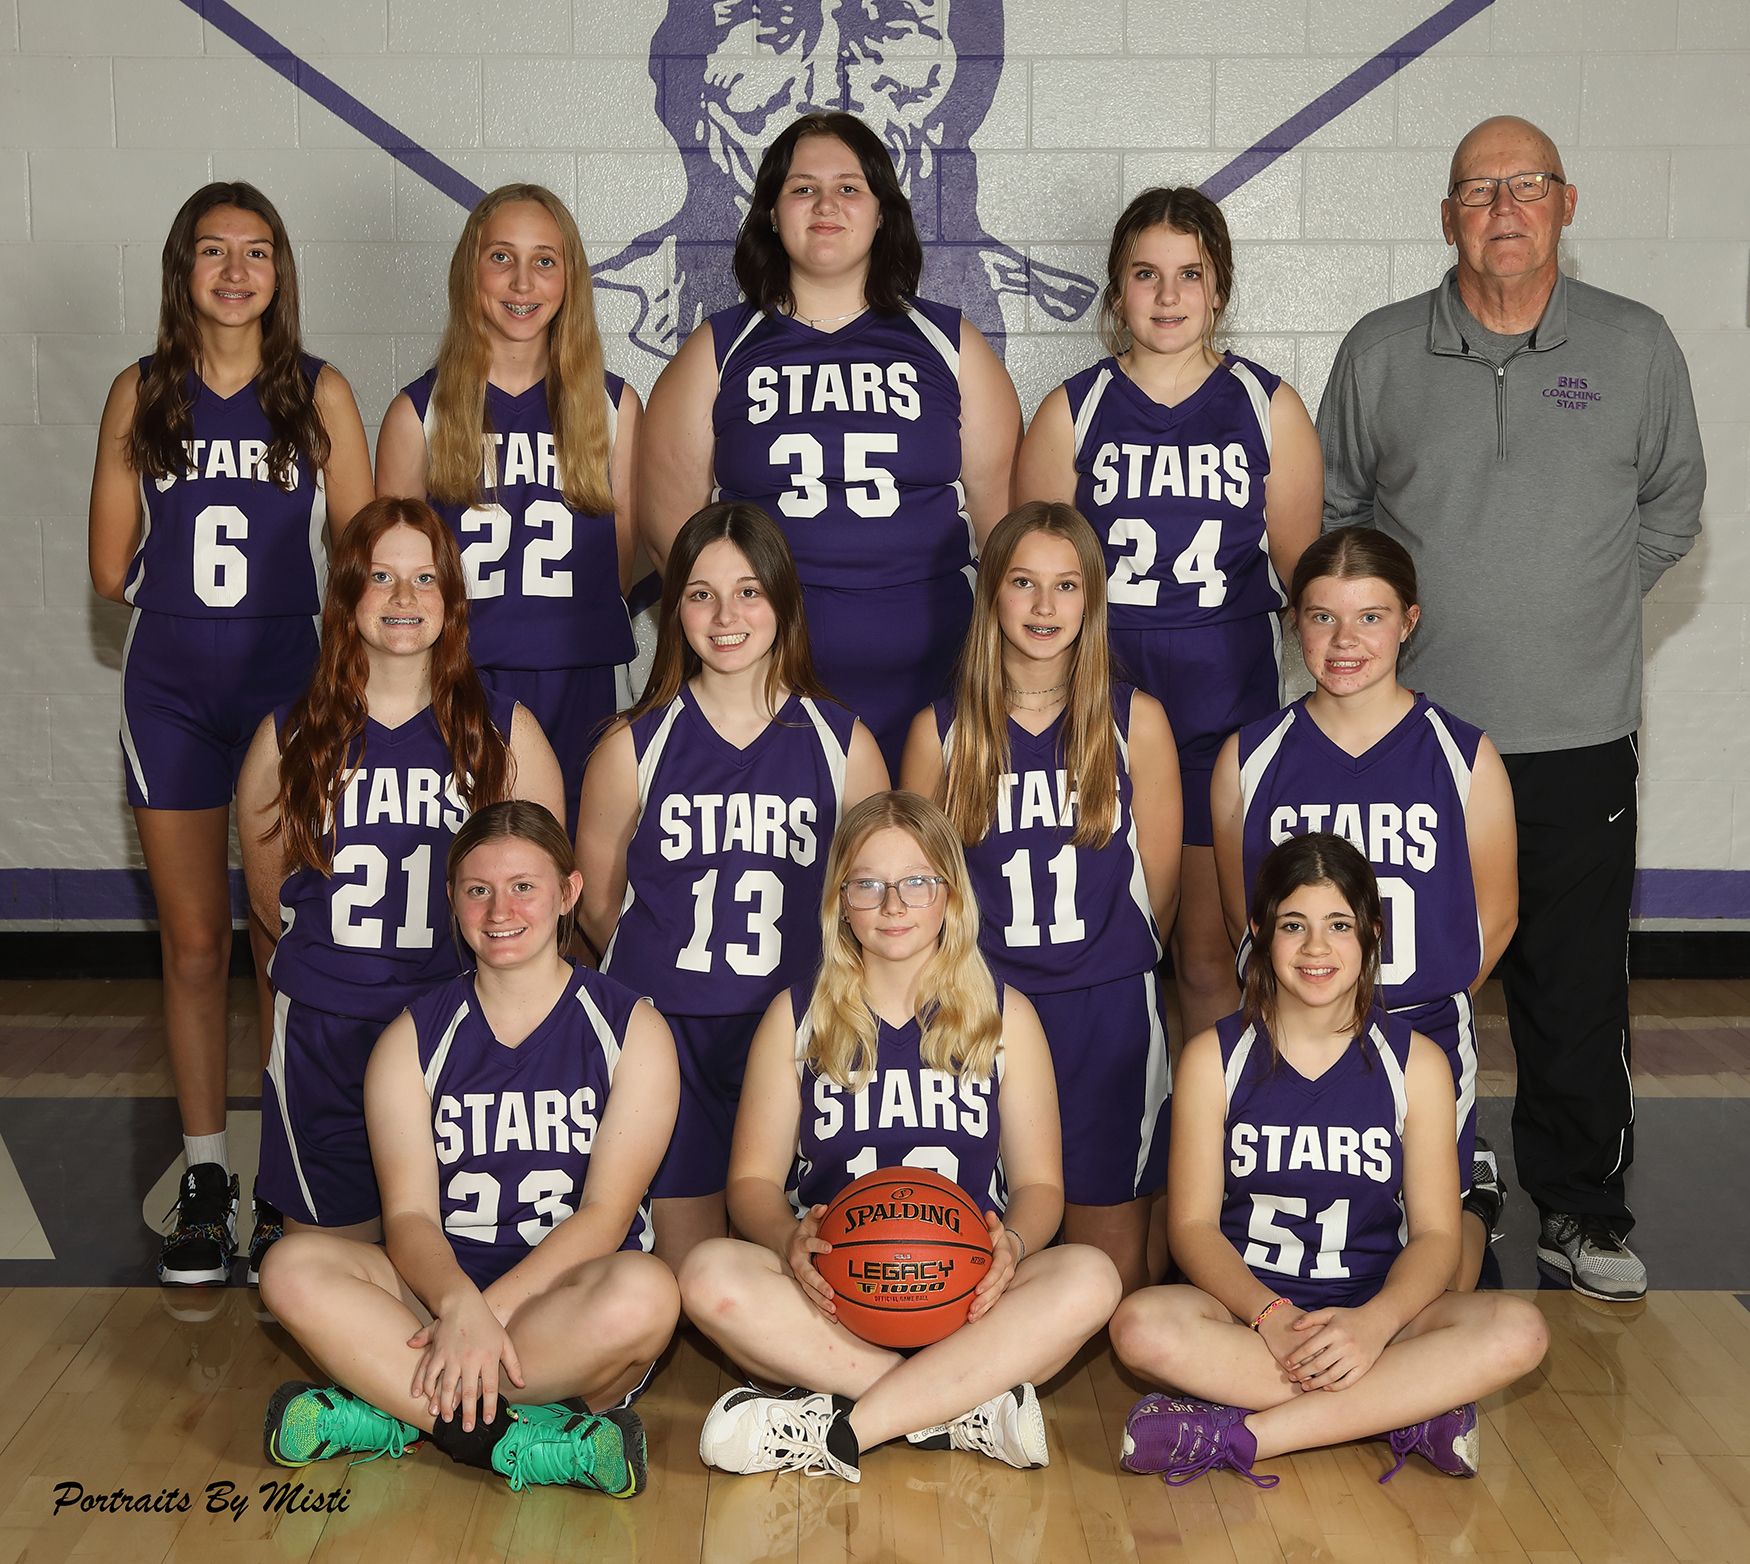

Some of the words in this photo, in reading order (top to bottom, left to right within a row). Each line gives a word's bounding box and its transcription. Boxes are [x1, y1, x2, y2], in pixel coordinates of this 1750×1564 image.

[748, 361, 922, 425] STARS
[1542, 388, 1602, 401] COACHING
[1556, 399, 1588, 410] STAFF
[1557, 376, 1588, 389] BHS
[481, 431, 565, 491] TAR
[769, 432, 901, 519] 35
[1092, 442, 1251, 508] STARS
[193, 505, 249, 608] 6
[460, 499, 574, 600] 22
[1107, 517, 1228, 608] 24
[660, 792, 818, 868] STARS
[331, 844, 434, 949] 21
[675, 868, 785, 977] 13
[1001, 844, 1086, 948] 11
[1373, 876, 1417, 986] 0
[434, 1086, 599, 1165] STARS
[813, 1068, 992, 1142] STARS
[1230, 1122, 1392, 1184] STARS
[444, 1168, 576, 1247] 23
[844, 1202, 961, 1235] SPALDING
[1243, 1192, 1350, 1279] 51
[848, 1258, 955, 1282] LEGACY
[856, 1281, 878, 1295] TF
[879, 1281, 946, 1295] 1000
[874, 1295, 899, 1303] OFFICIAL
[900, 1295, 914, 1303] GAME
